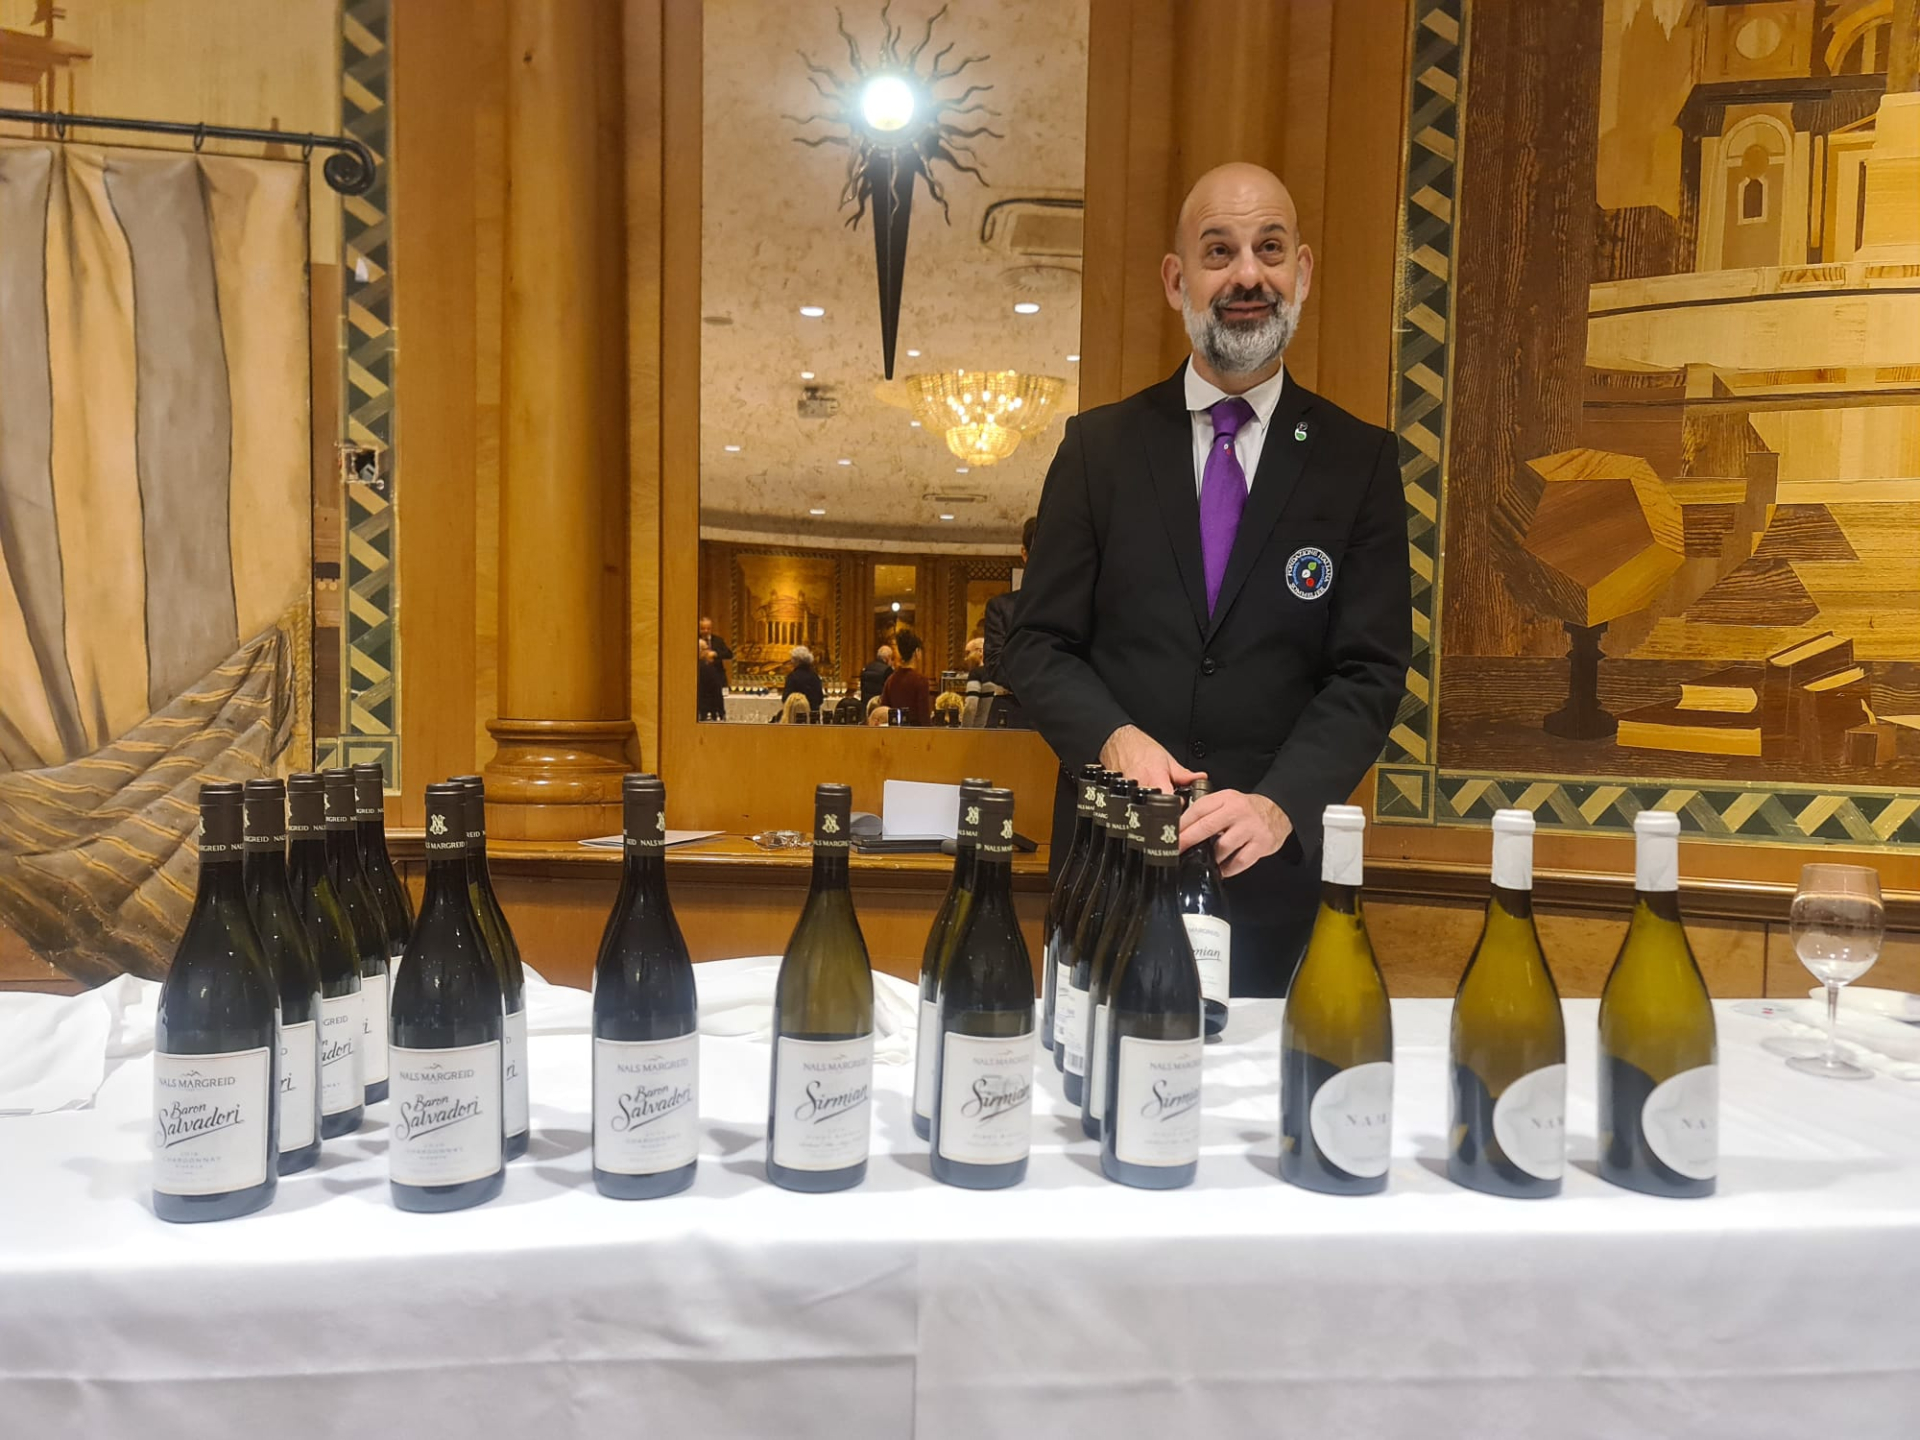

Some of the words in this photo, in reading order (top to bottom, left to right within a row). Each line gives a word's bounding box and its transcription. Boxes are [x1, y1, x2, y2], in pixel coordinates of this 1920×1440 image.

[399, 1070, 420, 1082] NALS
[420, 1069, 475, 1083] MARGREID
[617, 1063, 641, 1074] NALS
[803, 1062, 827, 1072] NALS
[178, 1076, 237, 1090] MARGREID
[412, 1094, 450, 1112] Baron
[634, 1085, 669, 1103] Baron
[794, 1080, 869, 1125] Sirmian
[170, 1100, 207, 1120] Baron
[611, 1083, 693, 1132] Salvadori
[156, 1103, 245, 1148] Salvadori
[395, 1095, 483, 1141] Salvadori
